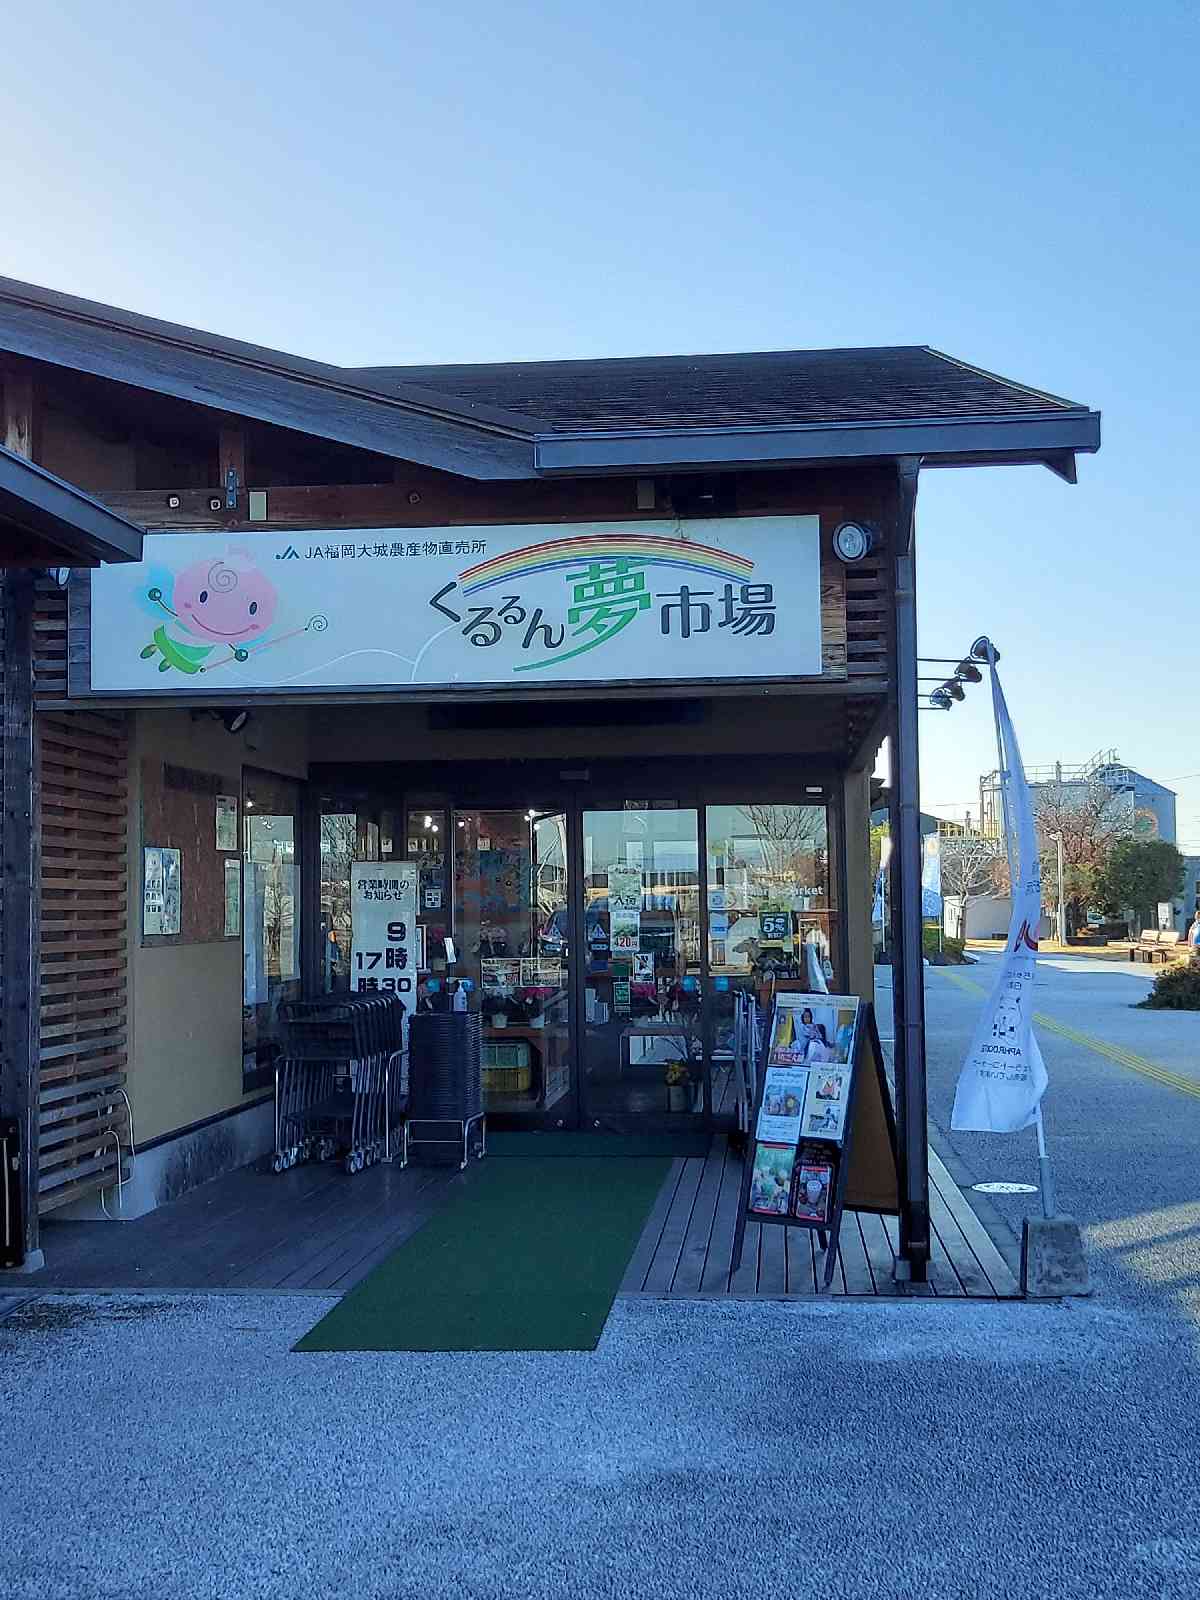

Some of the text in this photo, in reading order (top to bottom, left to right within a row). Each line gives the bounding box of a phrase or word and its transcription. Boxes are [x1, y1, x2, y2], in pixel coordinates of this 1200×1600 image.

[304, 540, 487, 560] JA福岡大城農産物直売所
[429, 558, 776, 672] くるるん夢市場
[358, 879, 410, 889] 営業時間の
[364, 890, 403, 900] お知らせ
